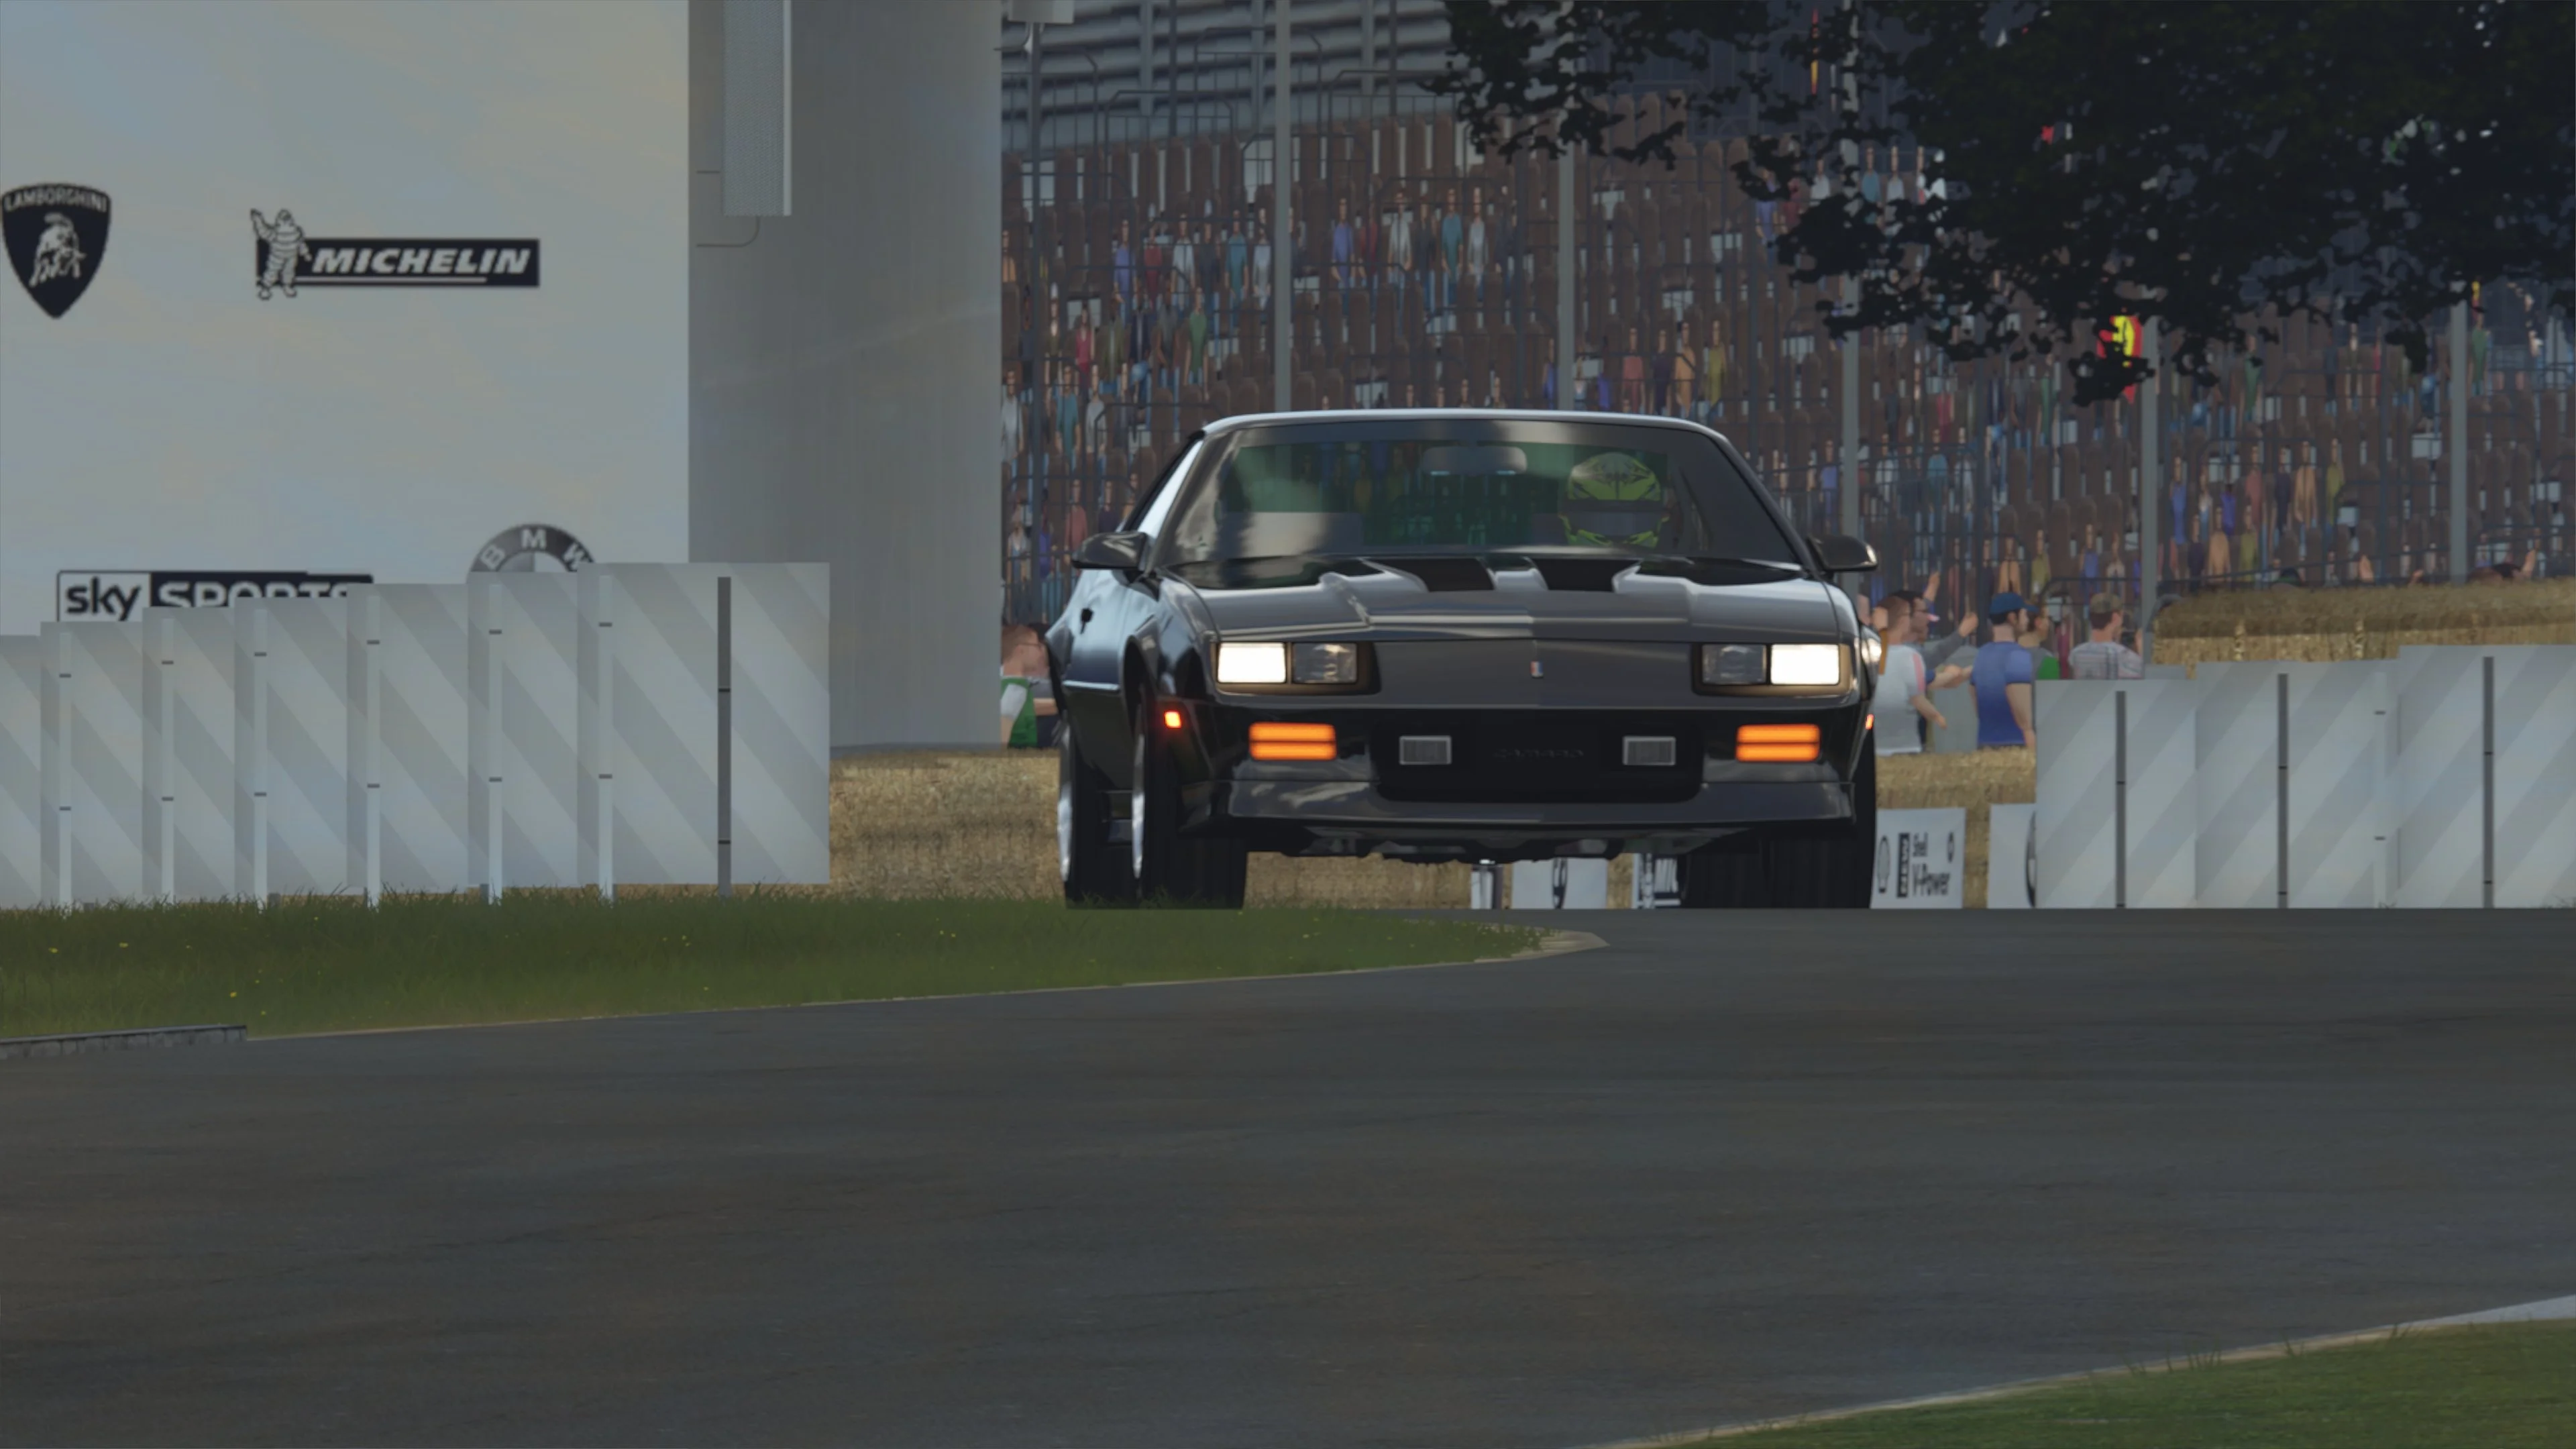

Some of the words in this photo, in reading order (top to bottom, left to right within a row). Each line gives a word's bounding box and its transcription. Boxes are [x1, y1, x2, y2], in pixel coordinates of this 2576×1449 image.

[3, 187, 107, 213] LAMBORGHINI
[311, 248, 531, 275] MICHELIN
[65, 576, 142, 621] sky
